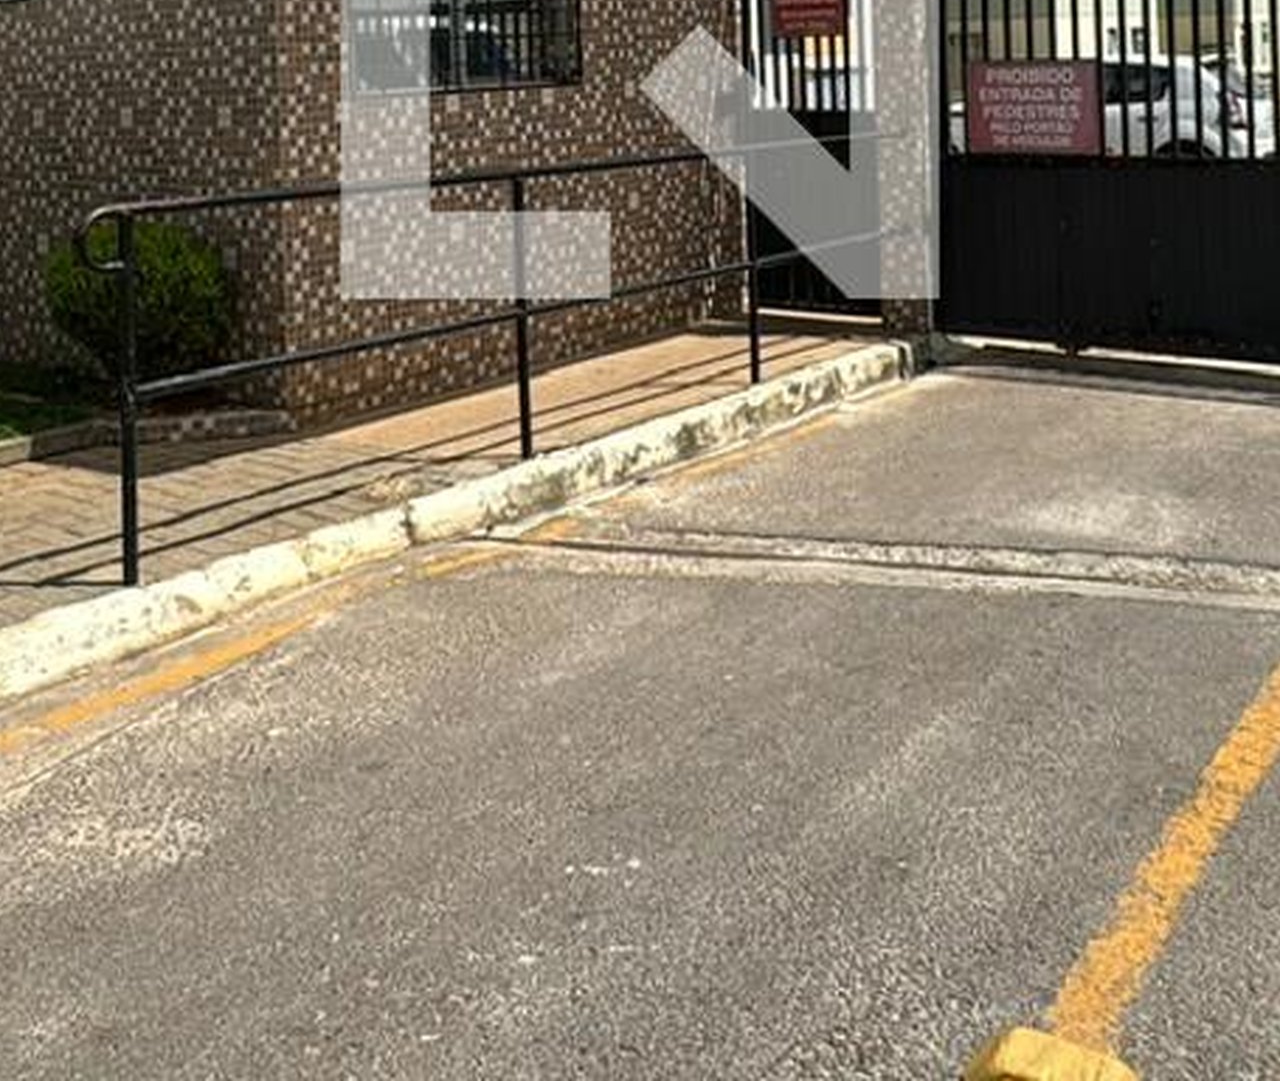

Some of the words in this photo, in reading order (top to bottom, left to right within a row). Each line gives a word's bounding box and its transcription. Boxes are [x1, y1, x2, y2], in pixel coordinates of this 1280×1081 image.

[986, 68, 1074, 84] PROIBIDO
[979, 86, 1055, 101] ENTRADA
[1059, 86, 1083, 101] DE
[983, 105, 1081, 120] PEDESTRES
